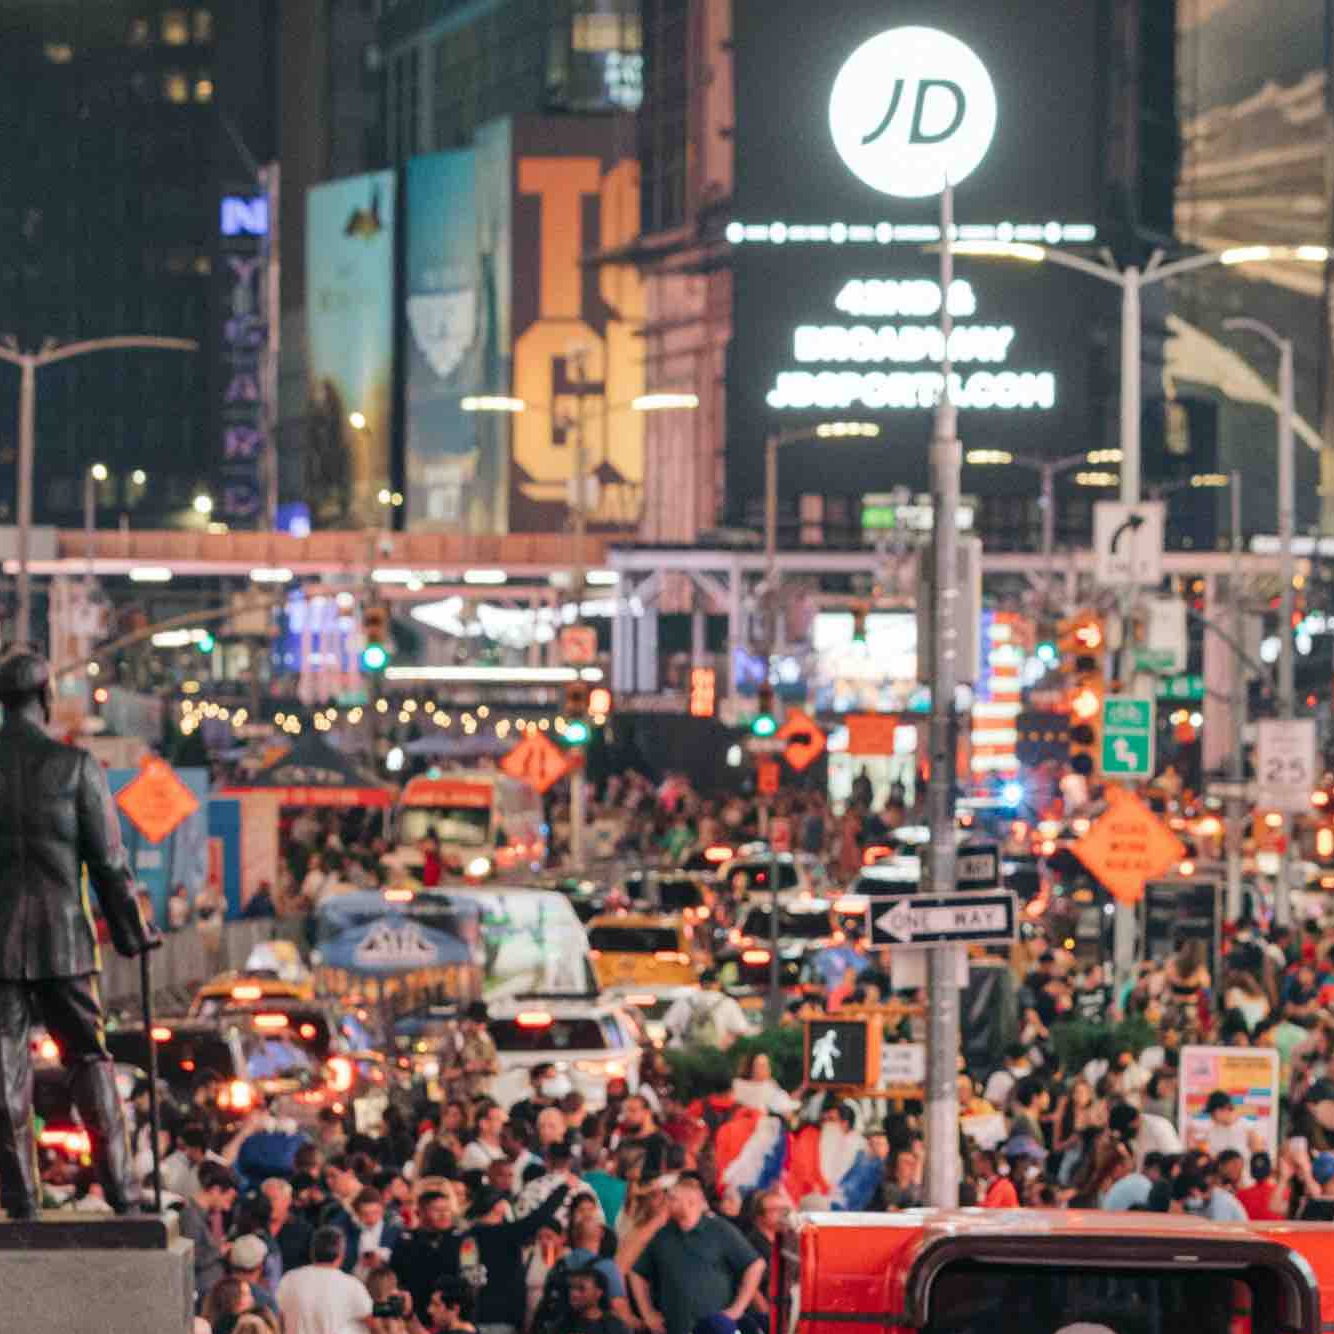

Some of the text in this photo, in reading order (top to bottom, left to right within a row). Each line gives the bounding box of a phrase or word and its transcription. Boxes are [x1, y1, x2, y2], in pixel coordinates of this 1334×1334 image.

[860, 78, 967, 145] JD
[1267, 757, 1308, 783] 25
[890, 909, 997, 931] ONE WAY
